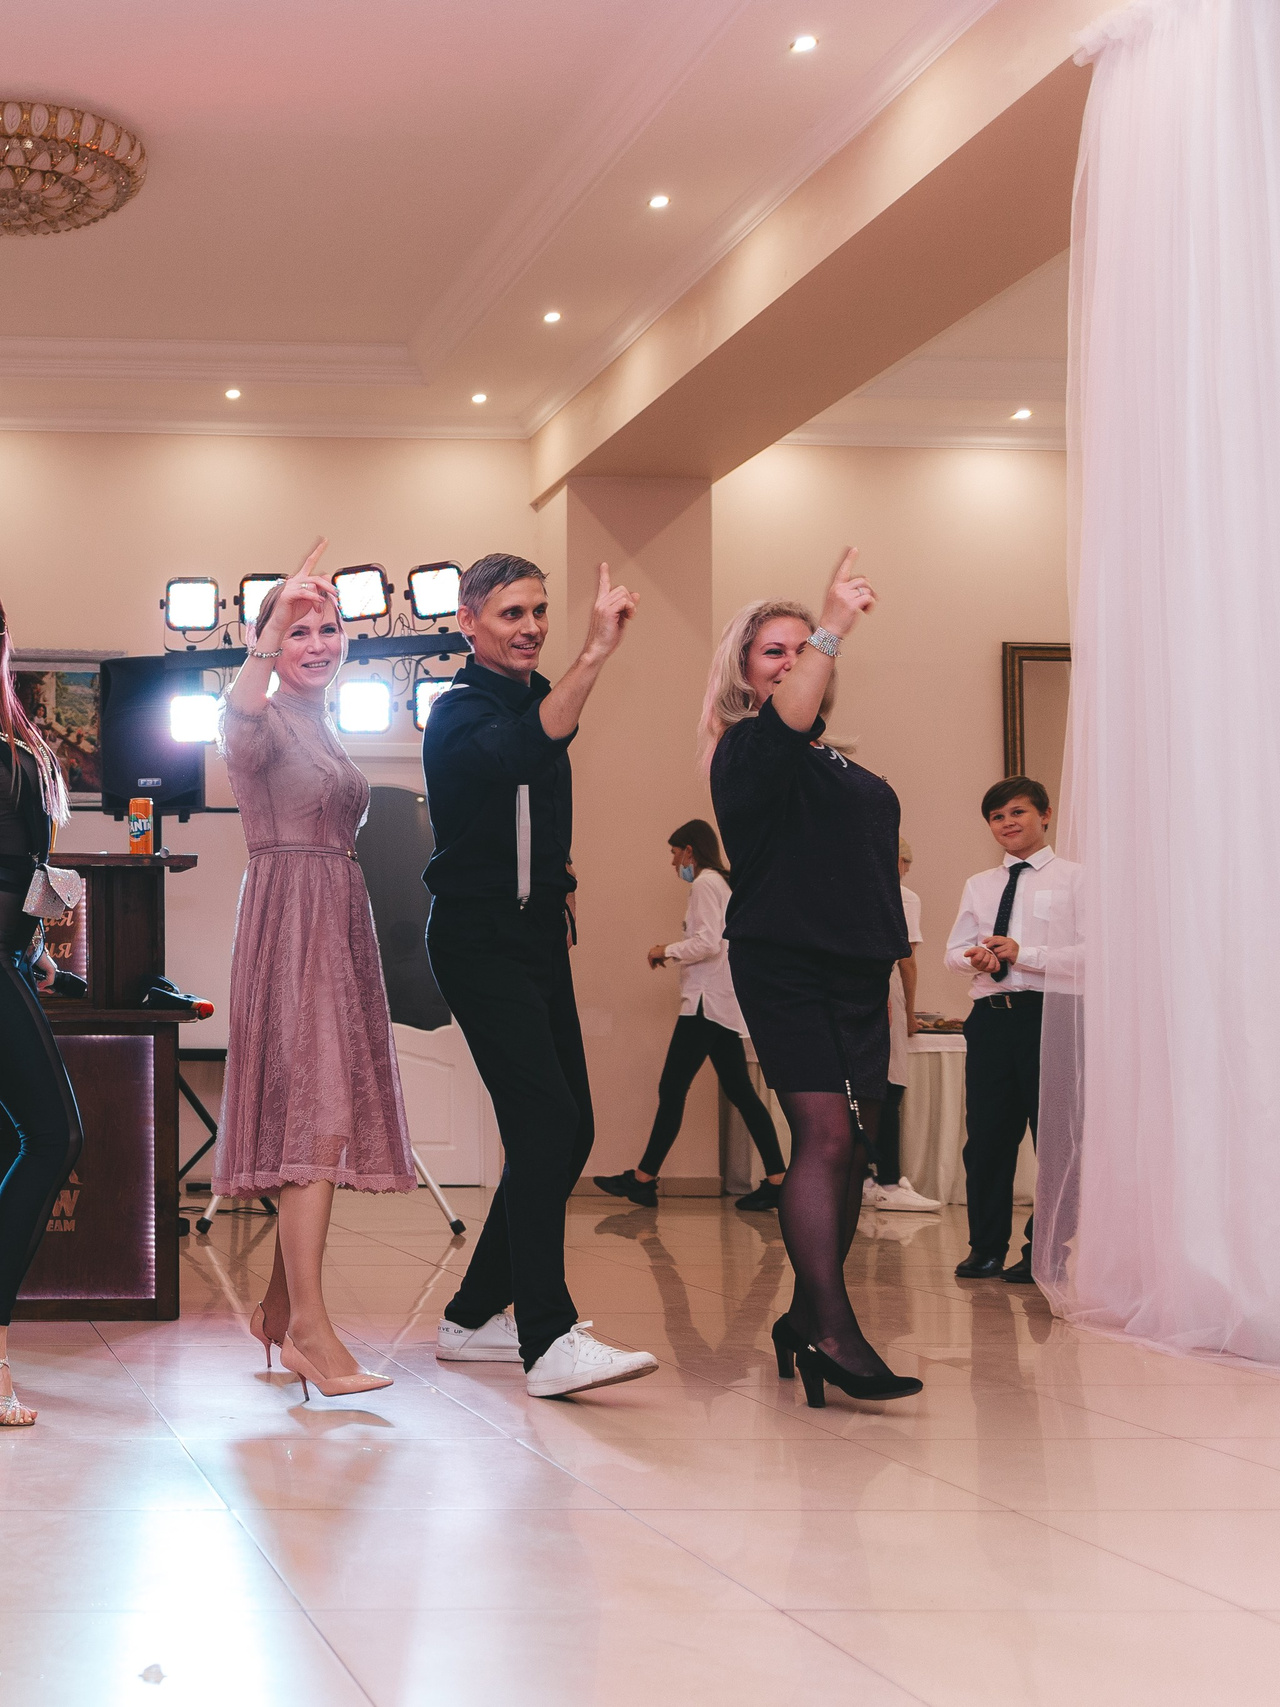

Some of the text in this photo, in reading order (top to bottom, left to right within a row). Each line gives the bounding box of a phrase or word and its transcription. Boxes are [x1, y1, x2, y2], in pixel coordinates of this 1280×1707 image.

[130, 818, 151, 832] ANTA
[45, 1219, 76, 1232] EAM
[437, 1325, 450, 1333] IVE
